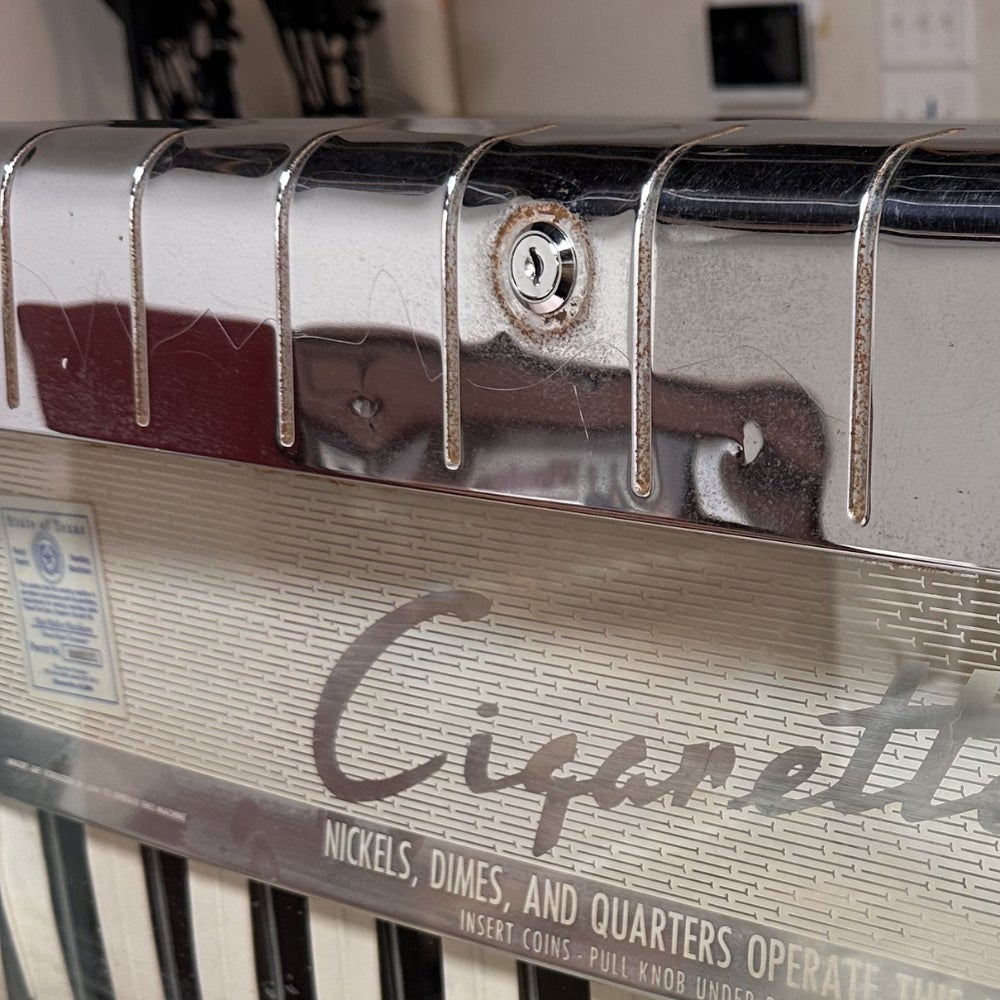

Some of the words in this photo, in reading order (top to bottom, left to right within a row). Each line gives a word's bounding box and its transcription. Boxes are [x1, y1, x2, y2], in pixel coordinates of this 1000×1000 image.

[324, 819, 418, 888] NICKELS,
[430, 849, 511, 913] DIMES,
[523, 875, 578, 926] AND
[590, 892, 733, 969] QUARTERS
[460, 909, 514, 944] INSERT
[522, 927, 570, 961] COINS
[589, 946, 629, 979] PULL
[639, 960, 686, 995] KNOB
